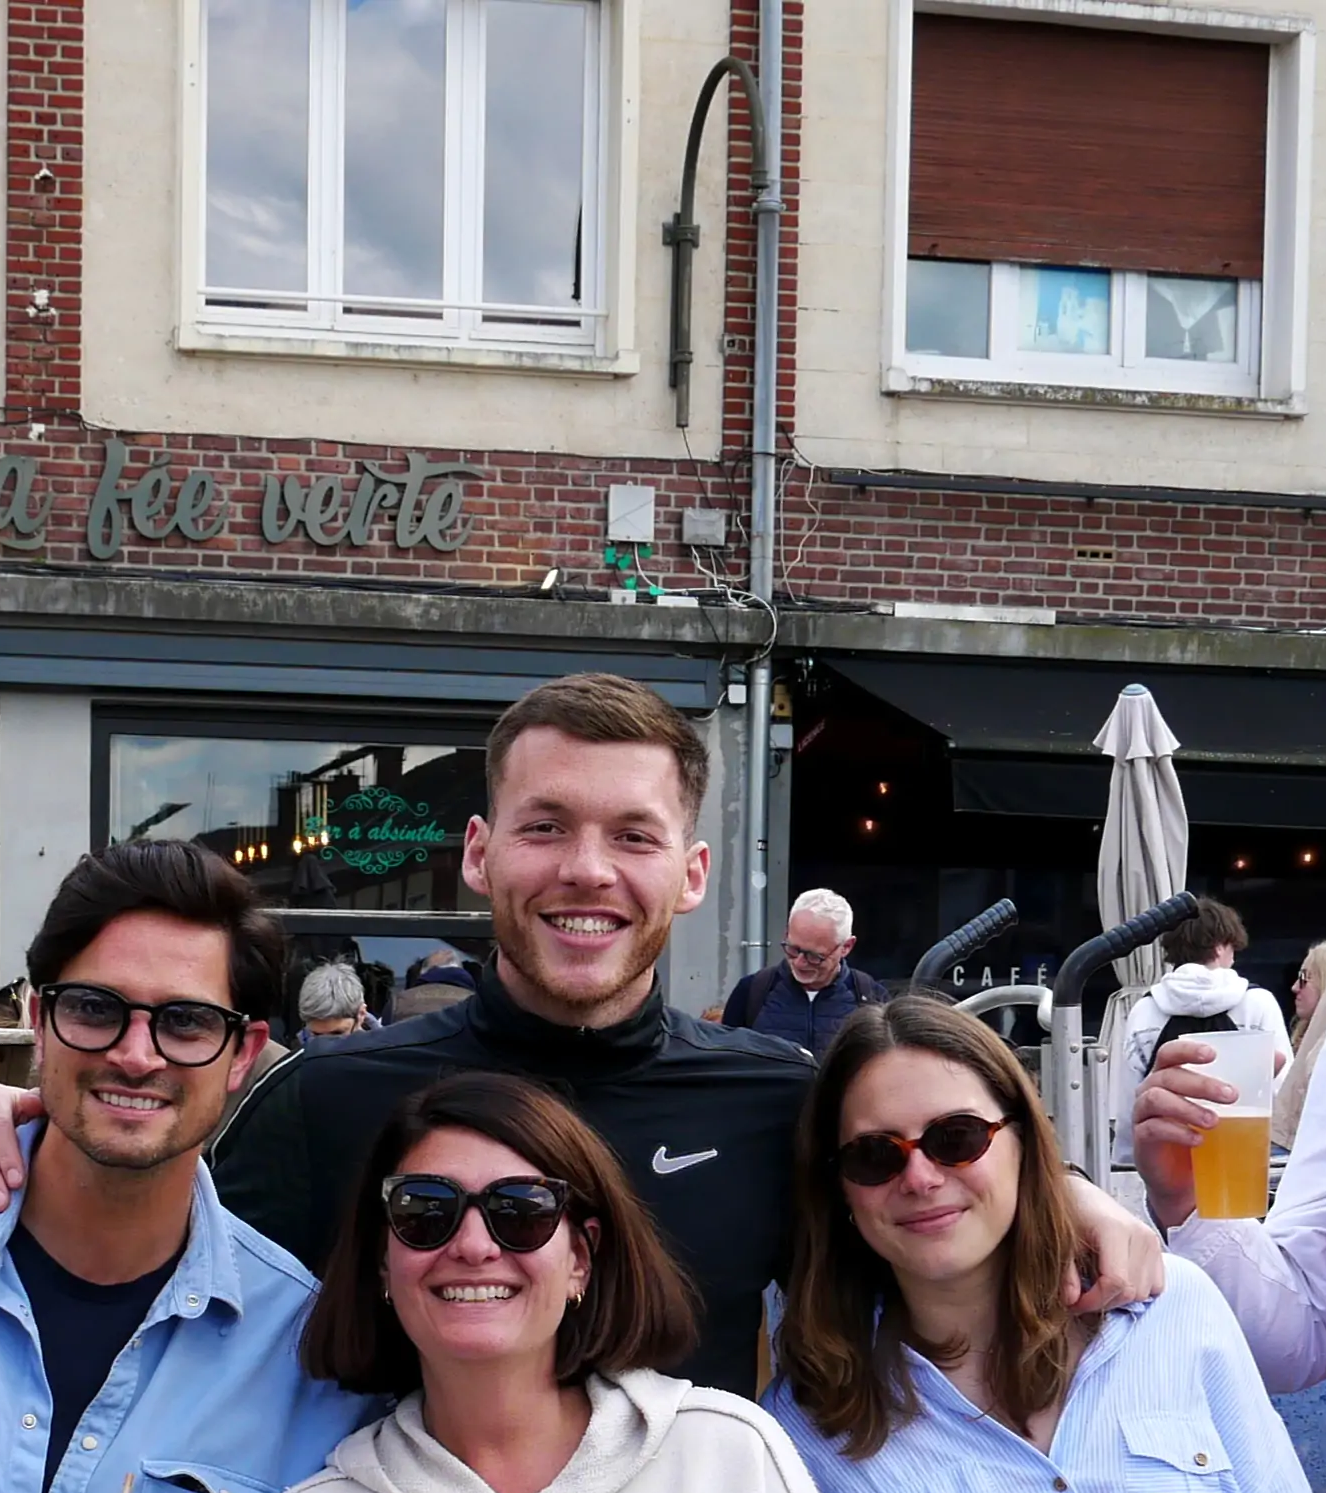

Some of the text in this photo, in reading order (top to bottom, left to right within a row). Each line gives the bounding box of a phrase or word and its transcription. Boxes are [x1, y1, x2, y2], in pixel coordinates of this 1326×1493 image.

[87, 438, 230, 560] fée
[262, 452, 486, 552] verte
[348, 821, 362, 840] à
[367, 817, 446, 842] absinthe
[953, 963, 1048, 987] CAFÉ
